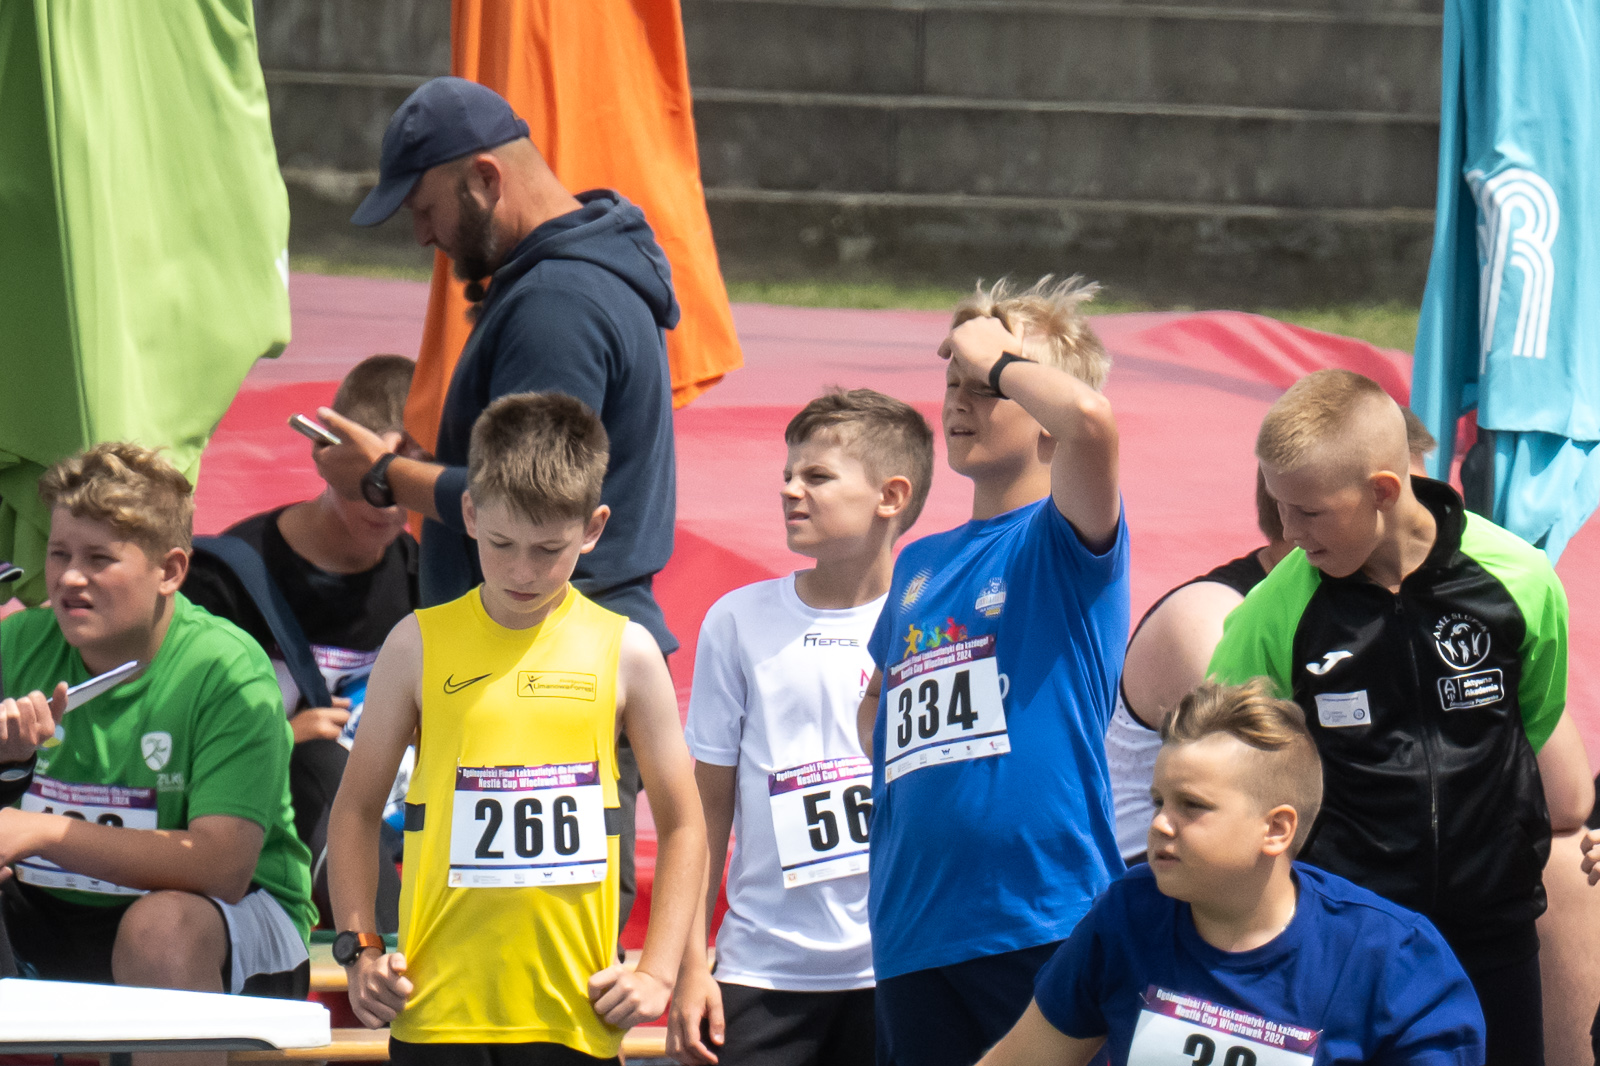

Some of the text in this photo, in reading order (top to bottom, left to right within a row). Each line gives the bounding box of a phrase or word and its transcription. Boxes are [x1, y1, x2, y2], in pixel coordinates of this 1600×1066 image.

[897, 669, 979, 749] 334
[502, 778, 518, 790] Cup
[821, 770, 838, 781] Cup
[474, 795, 581, 859] 266
[802, 784, 873, 852] 56
[1201, 1012, 1218, 1028] Cup
[1264, 1030, 1286, 1047] 2024
[1265, 1020, 1278, 1032] dla
